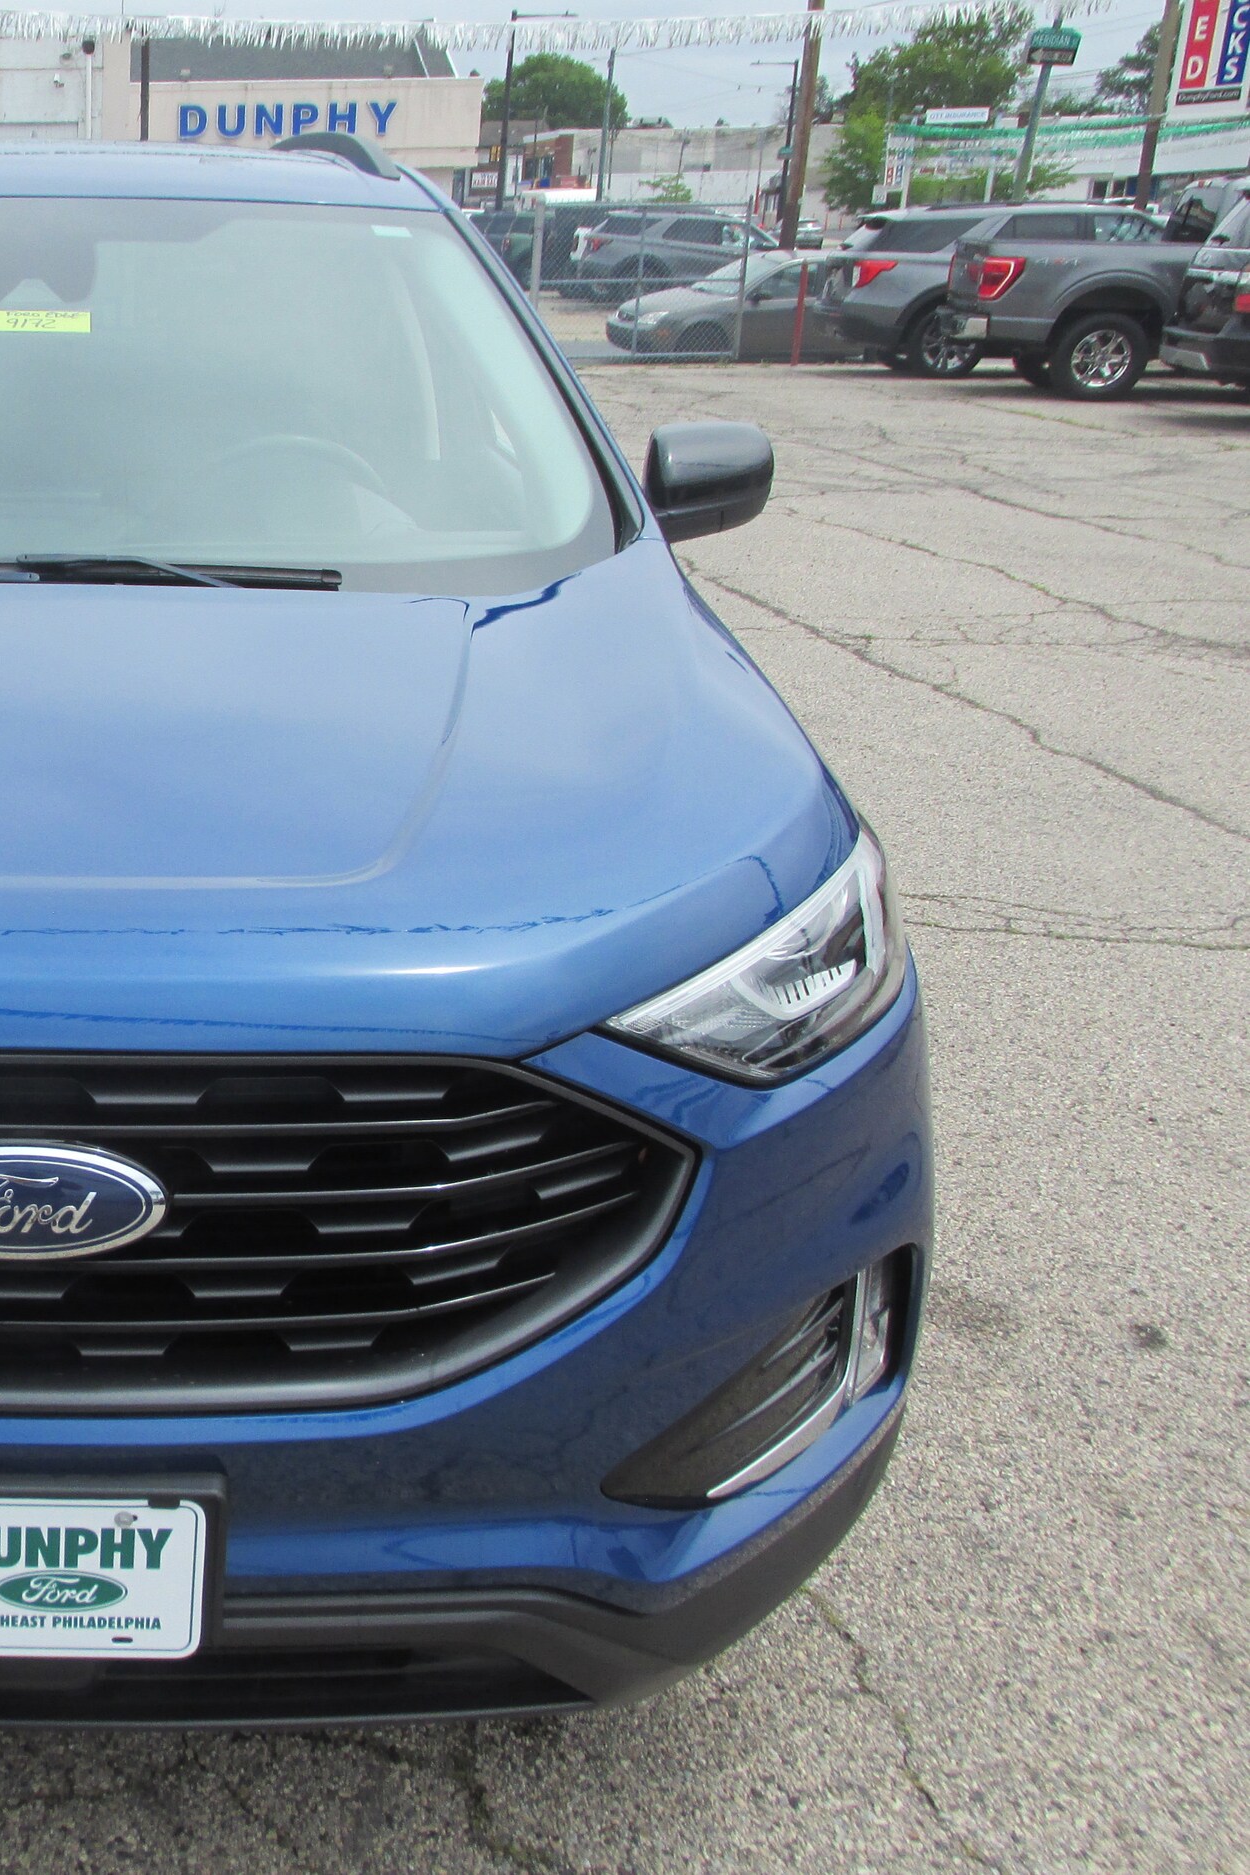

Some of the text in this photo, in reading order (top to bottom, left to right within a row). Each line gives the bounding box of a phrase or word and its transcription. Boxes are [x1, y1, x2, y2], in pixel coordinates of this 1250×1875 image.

[1185, 0, 1210, 81] ED
[1223, 0, 1250, 81] CKS
[178, 101, 398, 139] DUNPHY
[6, 318, 56, 328] 9172
[21, 1574, 99, 1604] Ford
[51, 1614, 162, 1630] PHILADELPHIA
